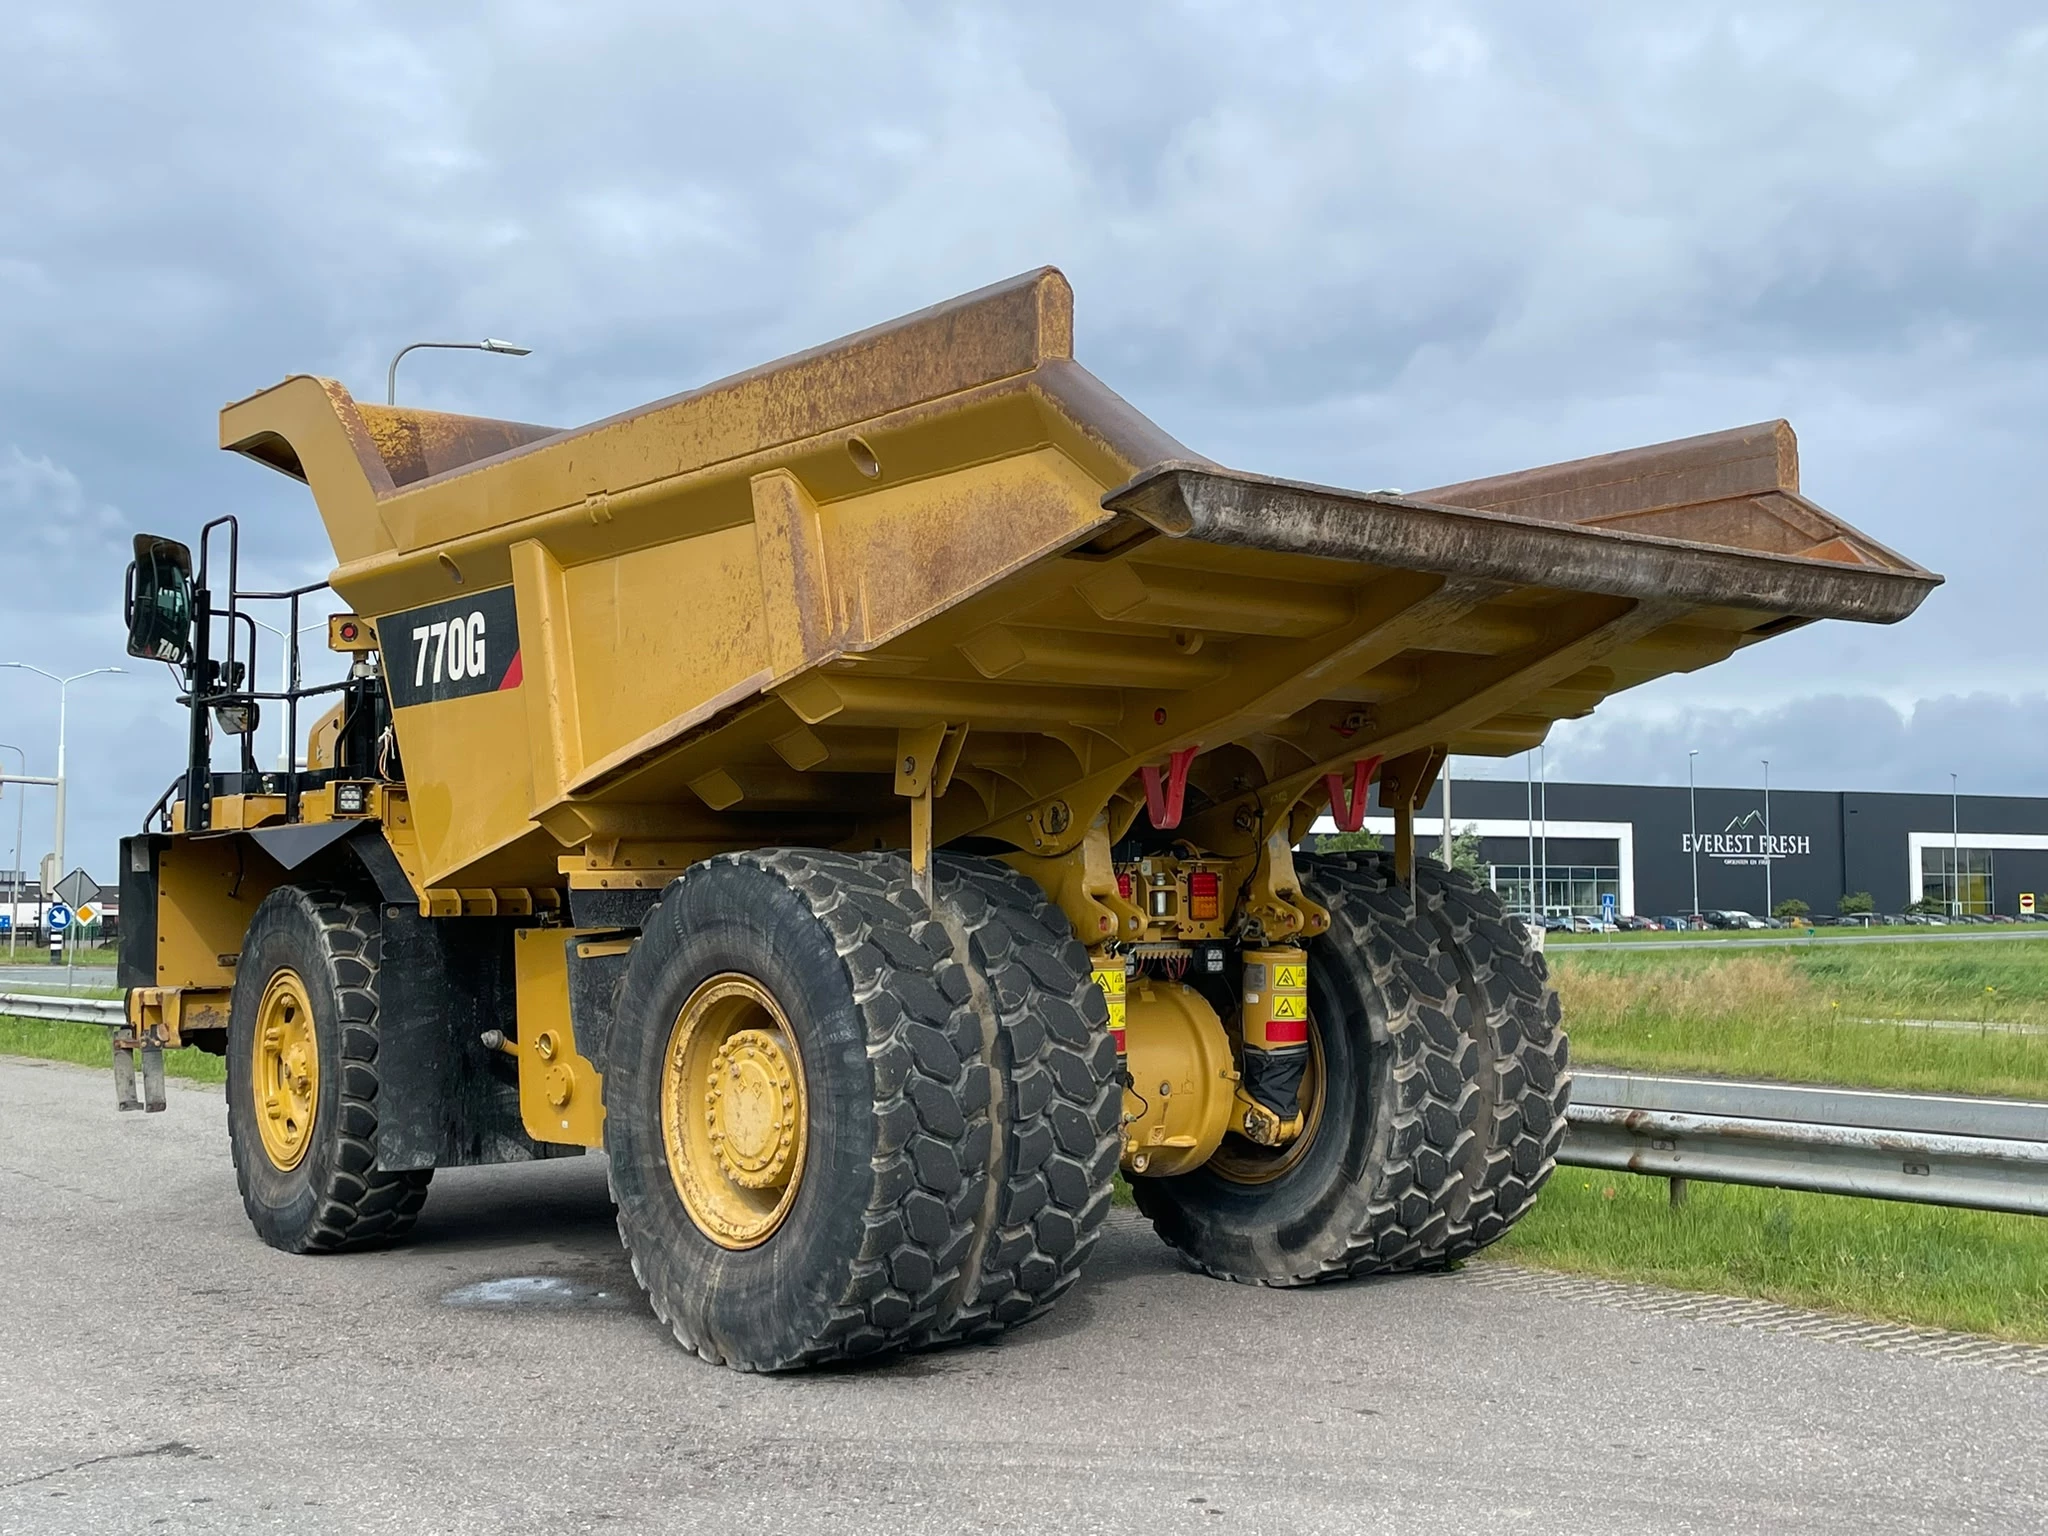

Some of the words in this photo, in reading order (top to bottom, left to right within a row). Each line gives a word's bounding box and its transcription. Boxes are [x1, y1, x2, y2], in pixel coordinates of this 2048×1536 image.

[413, 611, 486, 687] 770G
[1682, 833, 1754, 853] EVEREST
[1759, 834, 1811, 854] FRESH
